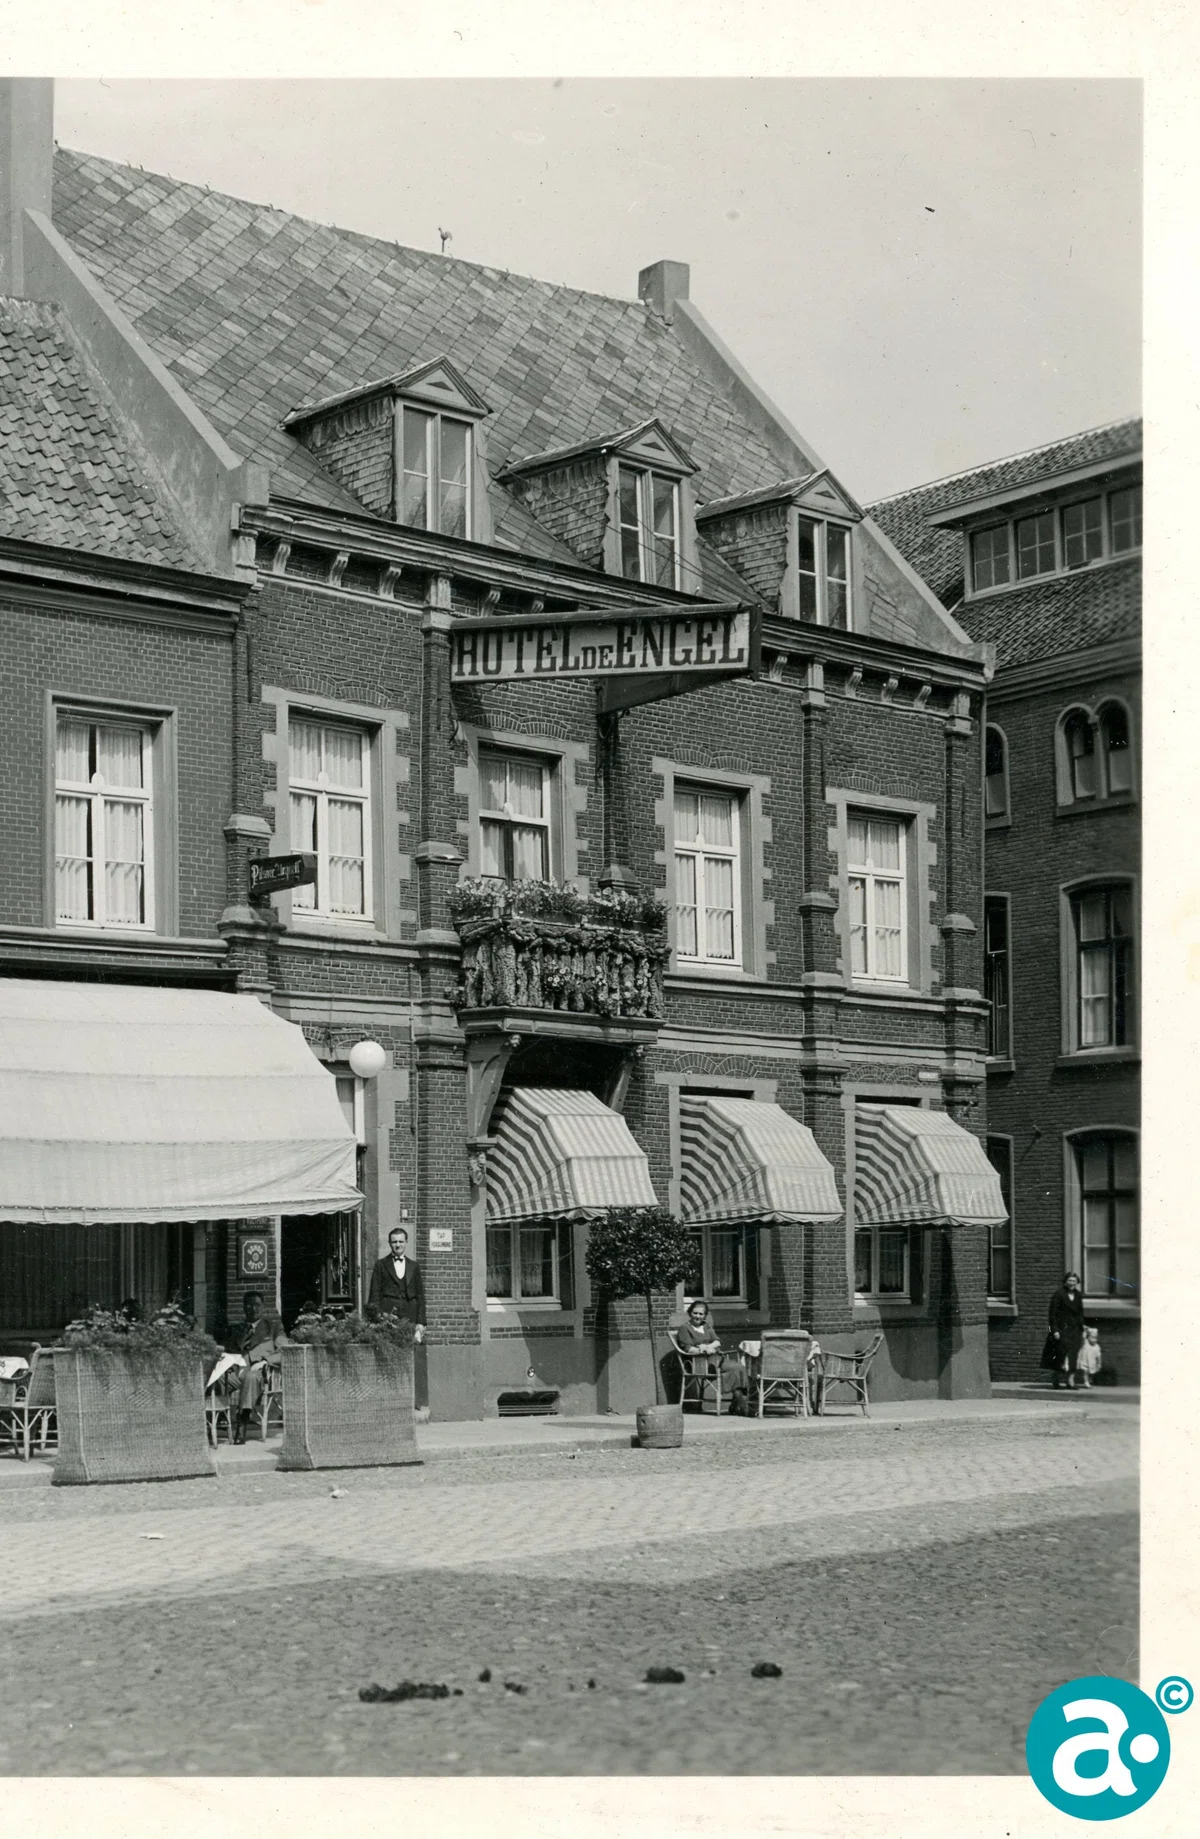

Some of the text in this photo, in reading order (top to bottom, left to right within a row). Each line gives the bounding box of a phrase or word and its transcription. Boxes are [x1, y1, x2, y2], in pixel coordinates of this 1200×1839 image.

[455, 616, 745, 677] HOTEL DE ENGEL
[247, 1260, 264, 1270] HOTEL
